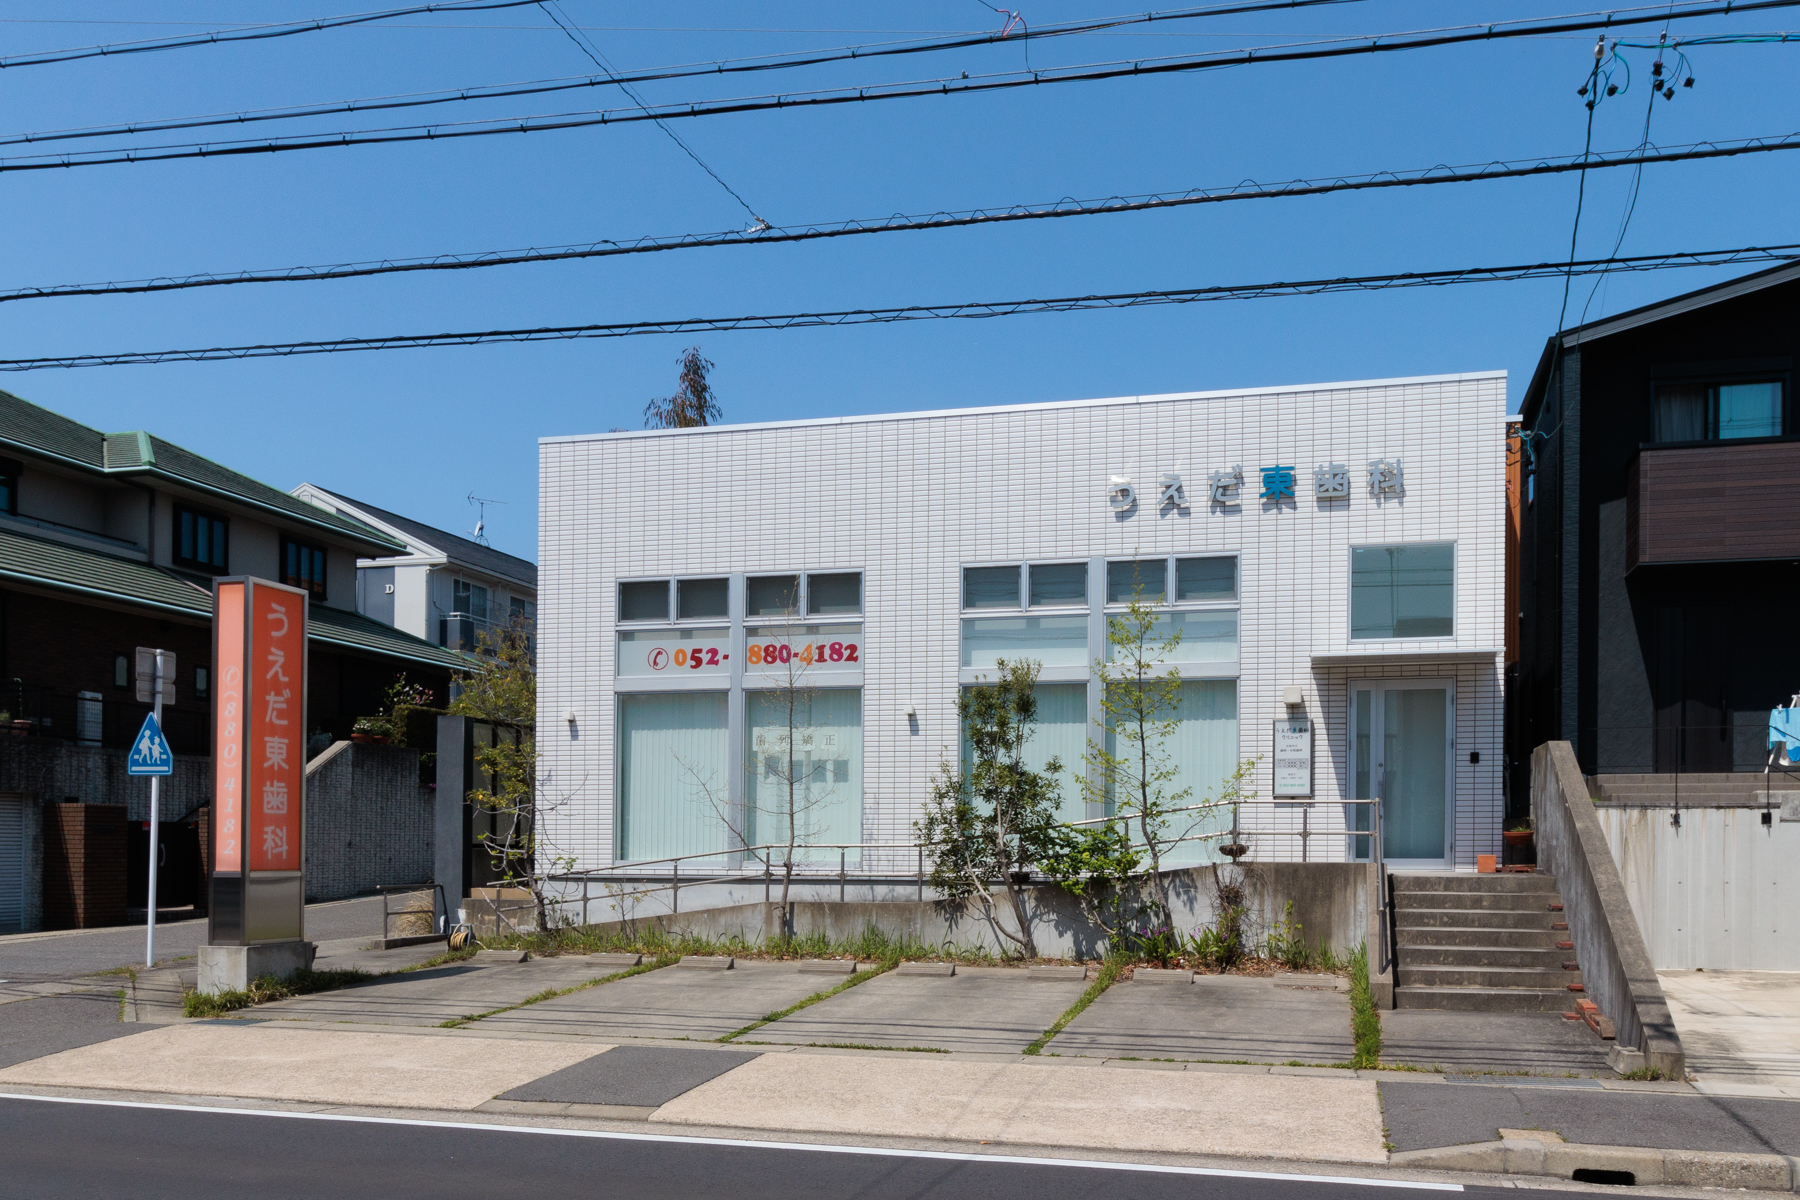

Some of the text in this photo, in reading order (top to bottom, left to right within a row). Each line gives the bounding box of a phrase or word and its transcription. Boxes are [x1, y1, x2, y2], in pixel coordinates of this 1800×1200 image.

[1107, 458, 1402, 509] うえだ東歯科
[385, 584, 394, 594] D
[262, 602, 291, 860] うえだ東歯科
